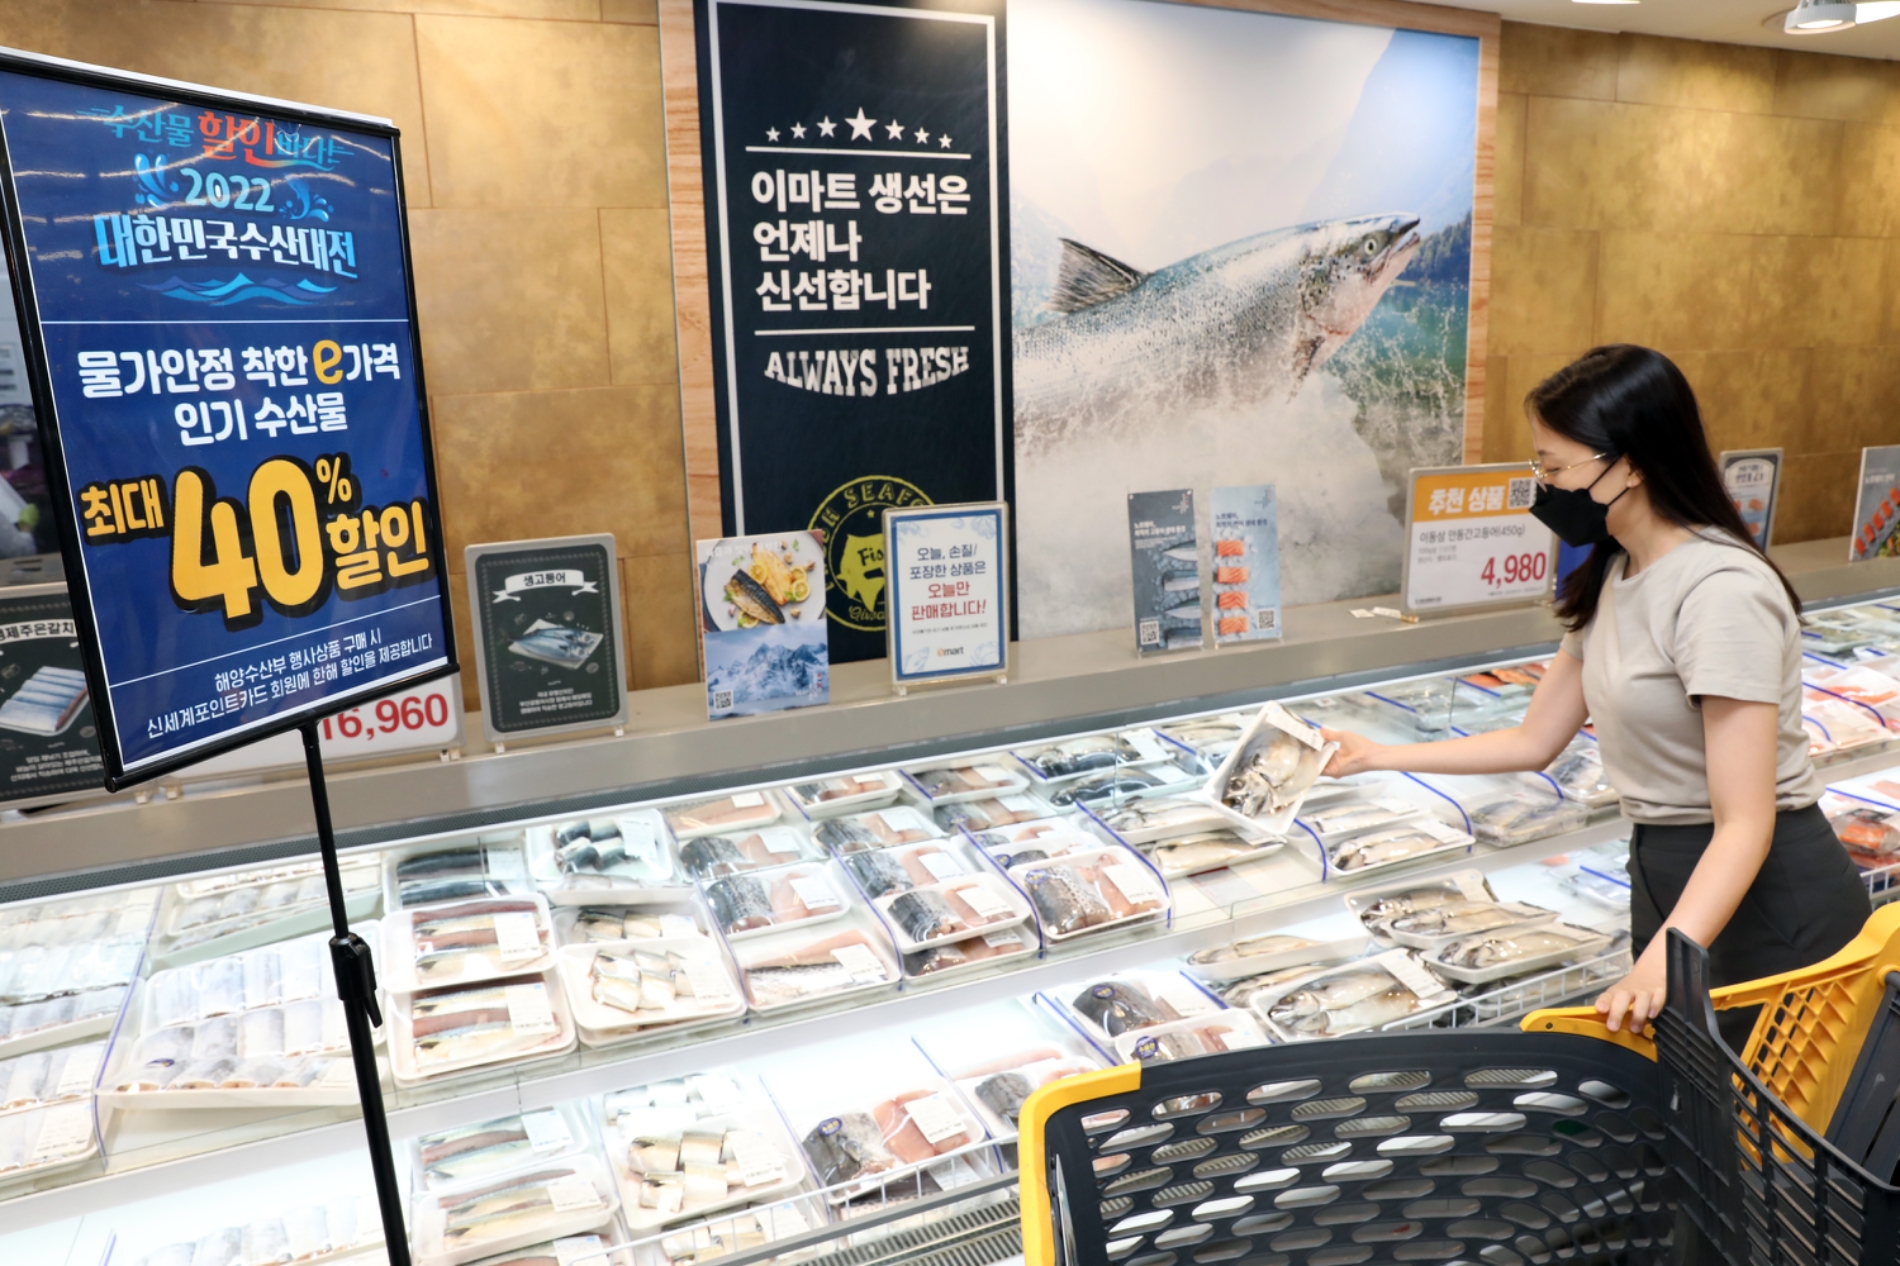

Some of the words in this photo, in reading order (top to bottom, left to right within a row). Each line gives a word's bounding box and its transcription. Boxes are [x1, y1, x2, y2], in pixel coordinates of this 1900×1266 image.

[102, 104, 195, 147] 수산물
[180, 167, 275, 213] 2022
[751, 169, 861, 213] 이마트
[868, 172, 971, 214] 생선은
[93, 213, 359, 279] 대한민국수산대전
[753, 219, 862, 262] 언제나
[756, 268, 932, 311] 신선합니다
[78, 347, 236, 399] 물가안정
[241, 346, 309, 388] 착한
[764, 348, 878, 397] ALWAYS
[885, 346, 969, 395] FRESH
[175, 397, 248, 447] 인기
[254, 391, 349, 439] 수산물
[1468, 485, 1506, 513] 상품
[80, 477, 165, 537] 최대
[325, 499, 430, 591] 할인
[917, 546, 945, 561] 오늘,
[523, 571, 566, 587] 생고등어
[909, 564, 947, 580] 포장한
[950, 560, 986, 577] 상품은
[928, 581, 970, 599] 오늘만
[1480, 552, 1547, 589] 4,980
[0, 621, 75, 641] 제주은갈치
[911, 599, 987, 621] 판매합니다!
[214, 657, 288, 694] 해양수산부
[288, 640, 342, 674] 행사상품
[342, 633, 368, 653] 구매
[369, 627, 383, 645] 시
[146, 684, 269, 739] 신세계포인트카드
[271, 671, 311, 700] 회원에
[313, 661, 339, 685] 한해
[340, 651, 378, 678] 할인을
[378, 632, 433, 664] 제공합니다
